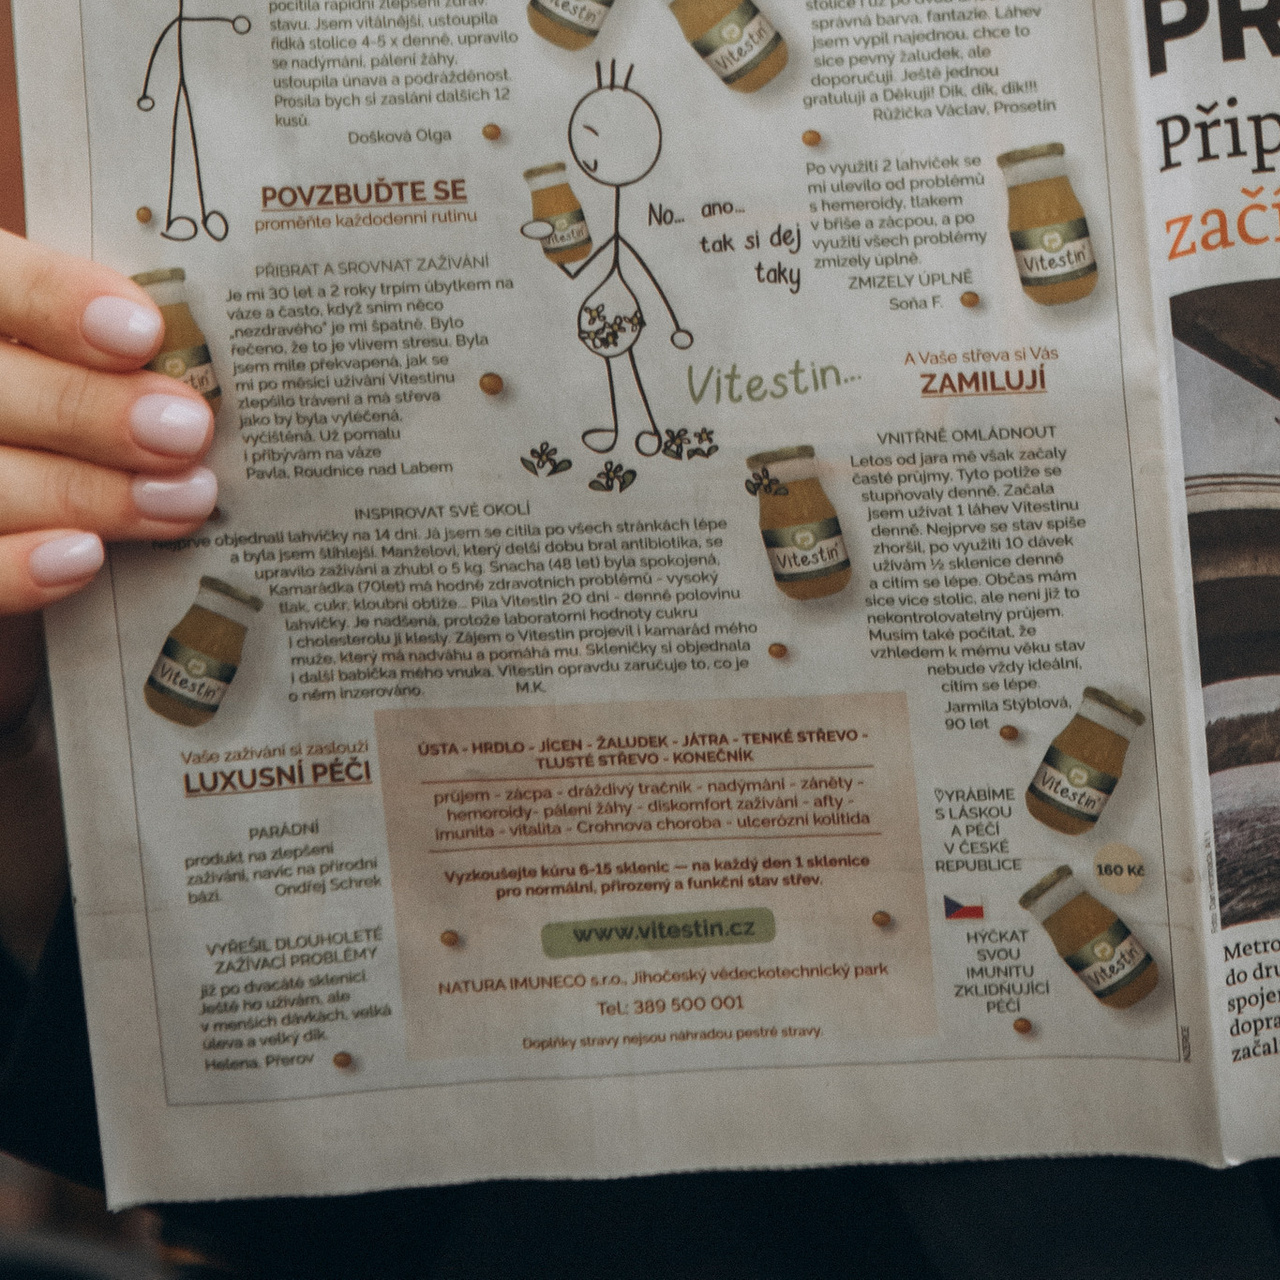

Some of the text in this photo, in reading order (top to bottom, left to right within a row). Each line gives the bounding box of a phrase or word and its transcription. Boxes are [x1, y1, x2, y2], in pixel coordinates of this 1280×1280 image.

[261, 178, 468, 207] POVZBUĎTE SE
[700, 224, 801, 254] tak si dej
[755, 262, 801, 294] taky
[921, 363, 1045, 394] ZAMILUJÍ
[184, 759, 372, 793] LUXUSNÍ PÉČI
[573, 919, 755, 943] www.vitestin.cz
